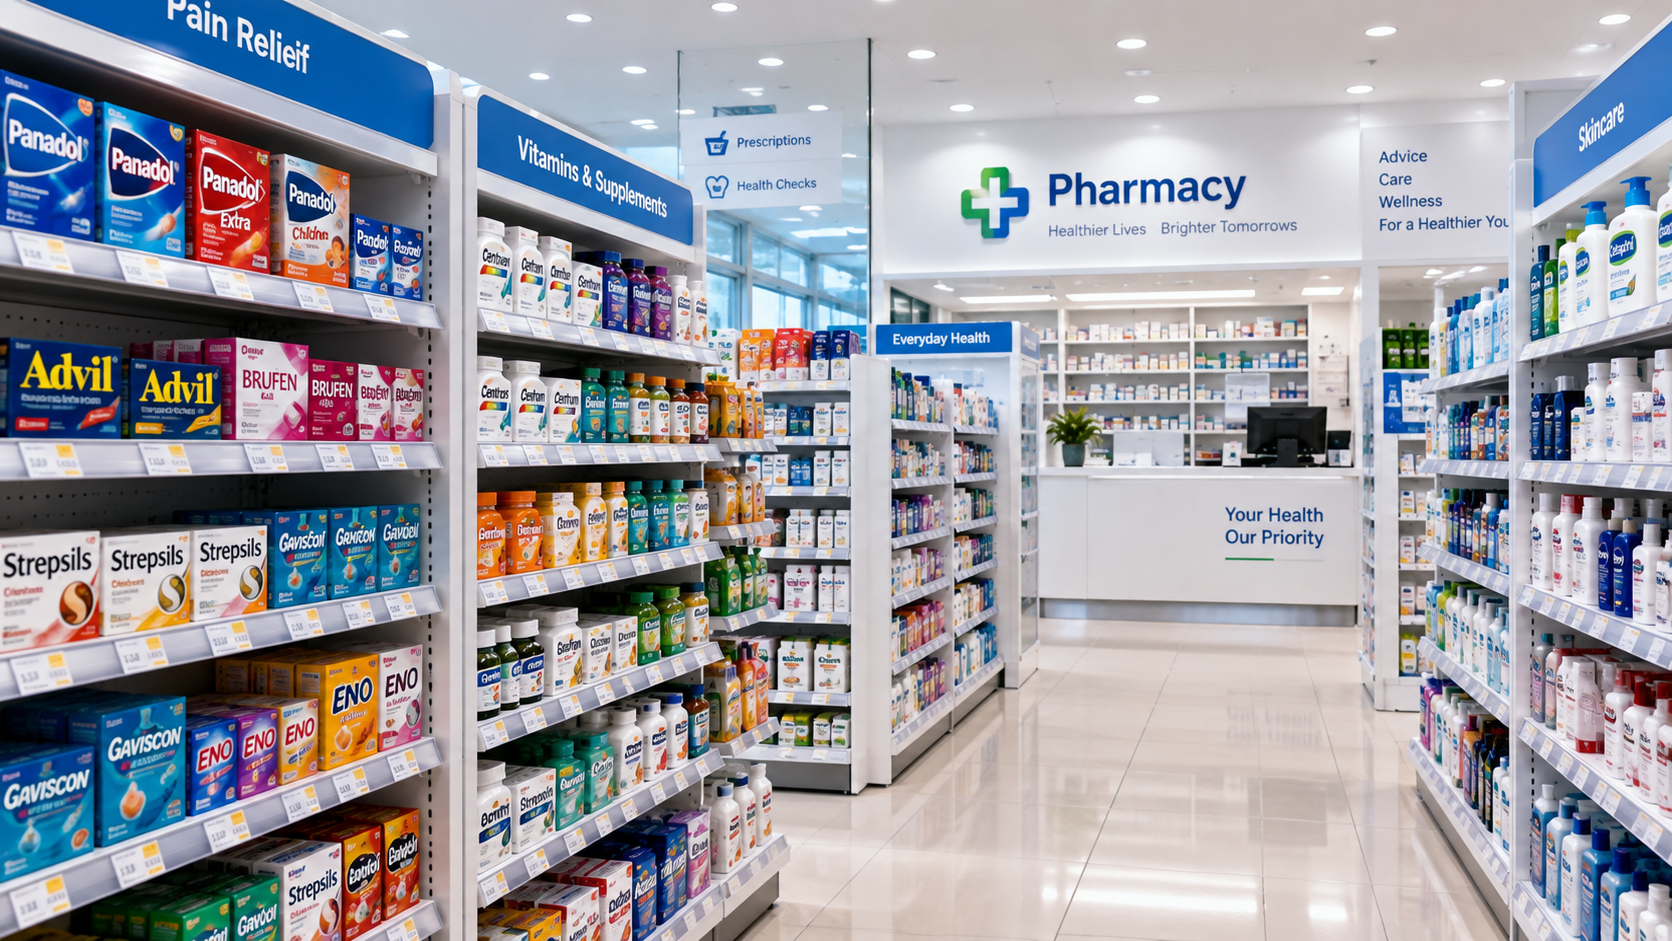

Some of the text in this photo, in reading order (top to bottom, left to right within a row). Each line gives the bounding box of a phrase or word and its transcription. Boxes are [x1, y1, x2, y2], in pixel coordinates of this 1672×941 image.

[168, 0, 228, 42] Pain
[9, 119, 82, 162] Panadol
[737, 135, 812, 149] Prescriptions
[1578, 102, 1625, 152] Skincare
[112, 147, 174, 185] Panadol
[1379, 150, 1428, 163] Advice
[203, 166, 260, 203] Panadol
[517, 134, 667, 218] Vitamins & Supplements
[737, 177, 817, 191] Health Checks
[1049, 172, 1247, 210] Pharmacy
[1379, 173, 1412, 186] Care
[289, 183, 335, 213] Panadol
[1379, 195, 1443, 208] Wellness
[220, 211, 251, 231] Extra
[1048, 219, 1297, 238] Healthier Lives Brighter Tomorrows
[1379, 218, 1402, 231] For
[1405, 220, 1414, 231] a
[1418, 216, 1482, 230] Healthier
[893, 331, 991, 348] Everyday Health
[19, 350, 114, 392] Advil
[139, 368, 214, 404] Advil
[242, 369, 298, 392] BRUFEN
[312, 379, 353, 399] BRUFEN
[1225, 506, 1324, 522] Your Health
[200, 535, 262, 564] Strepsils
[1225, 529, 1324, 549] Our Priority
[3, 546, 92, 579] Strepsils
[111, 544, 183, 573] Strepsils
[331, 676, 373, 715] ENO
[385, 667, 418, 698] ENO
[108, 726, 182, 762] GAVISCON
[244, 728, 276, 759] ENO
[285, 717, 315, 746] ENO
[197, 738, 233, 773] ENO
[3, 769, 90, 811] GAVISCON
[288, 869, 338, 907] Strepsils
